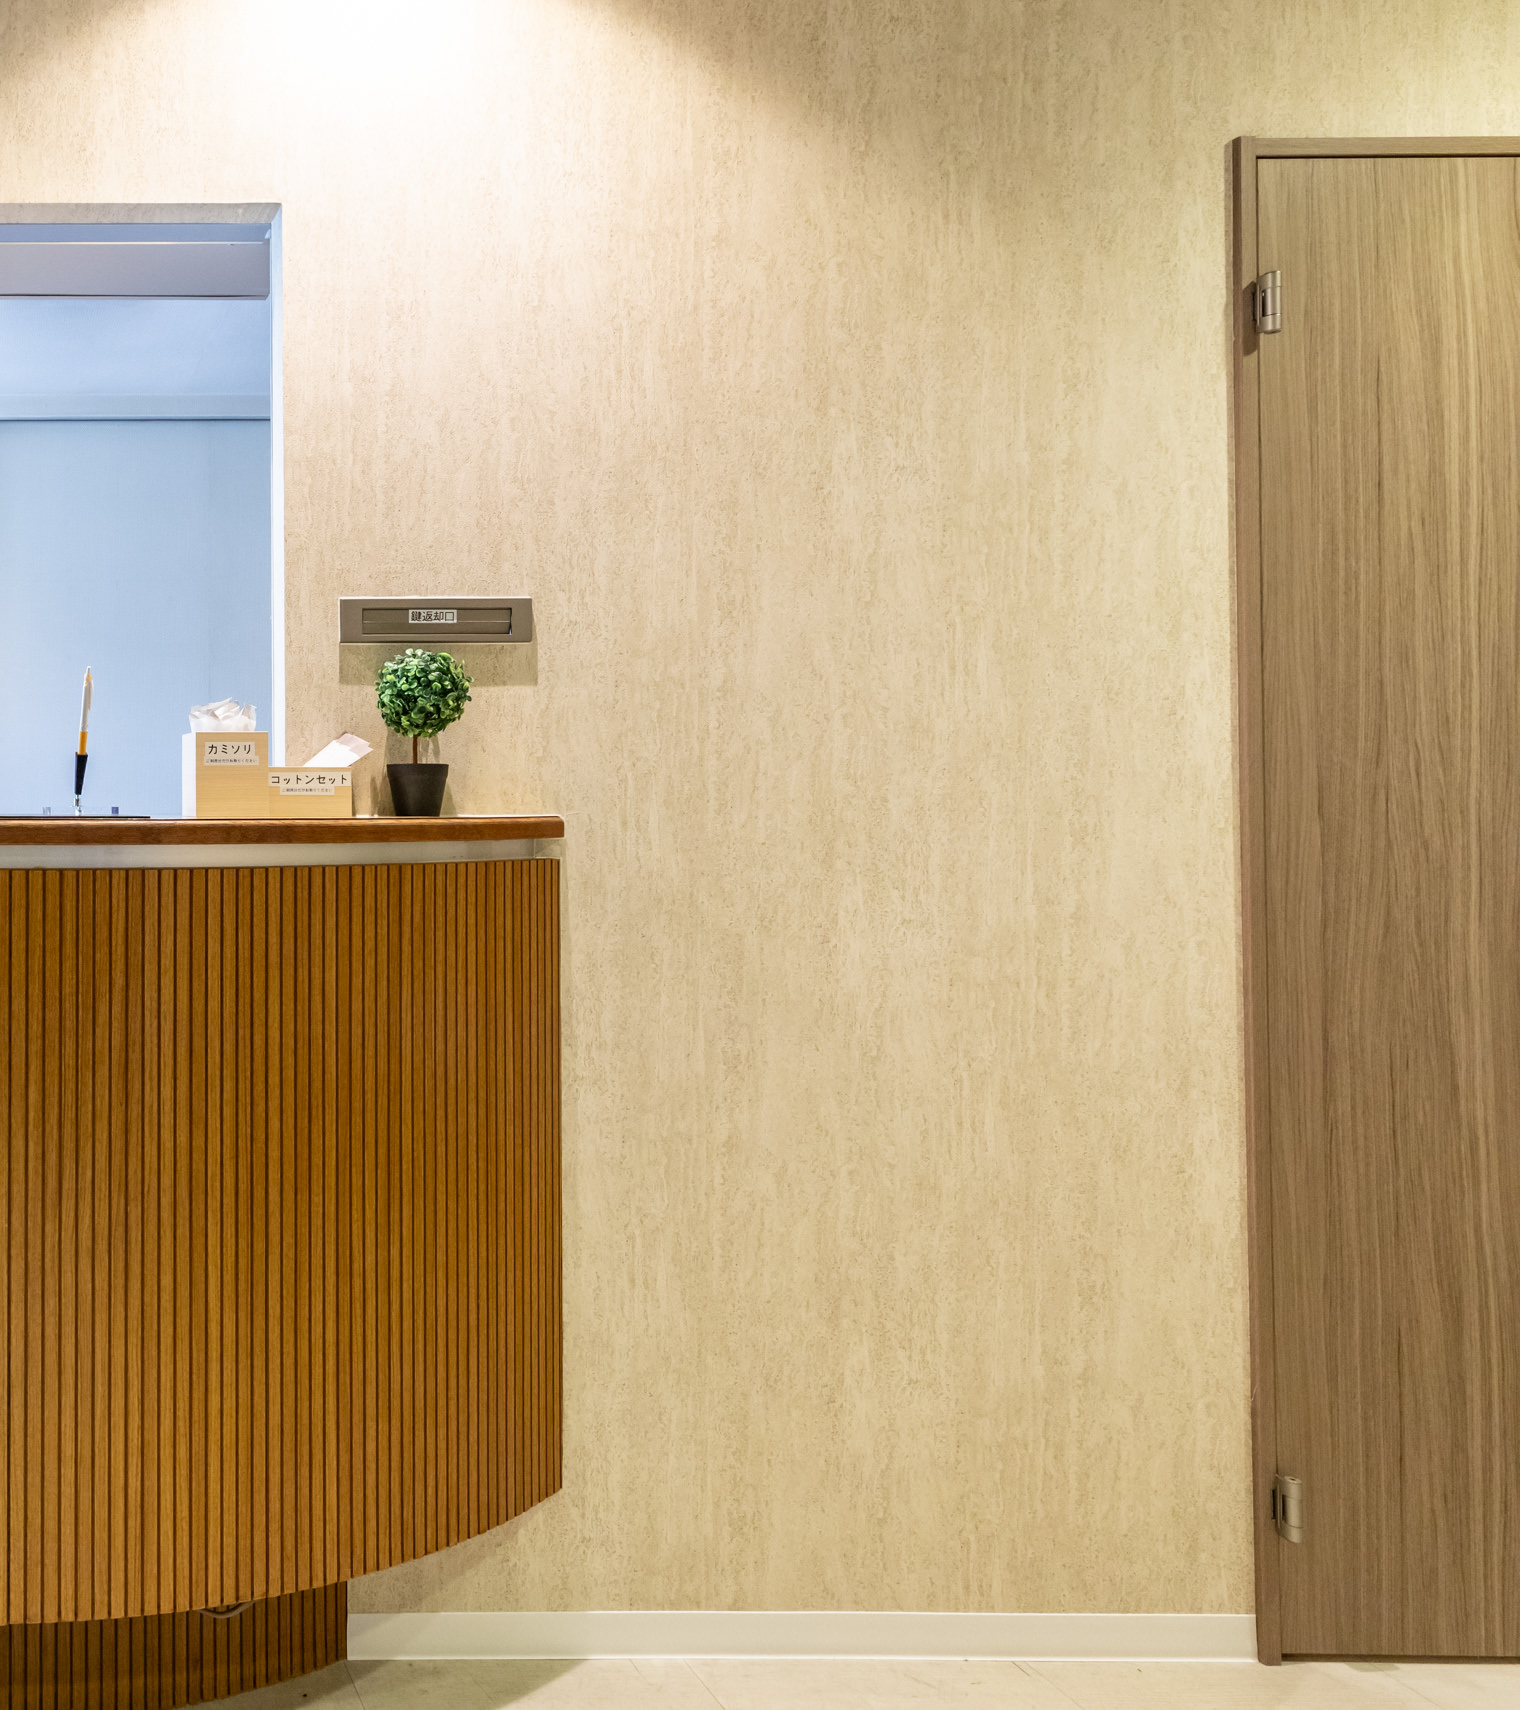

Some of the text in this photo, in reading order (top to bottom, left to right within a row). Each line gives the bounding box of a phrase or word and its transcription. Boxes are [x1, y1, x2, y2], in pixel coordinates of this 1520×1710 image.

[411, 611, 455, 622] 鍵返却口
[208, 744, 252, 755] カミソリ
[271, 774, 347, 785] コットンセット
